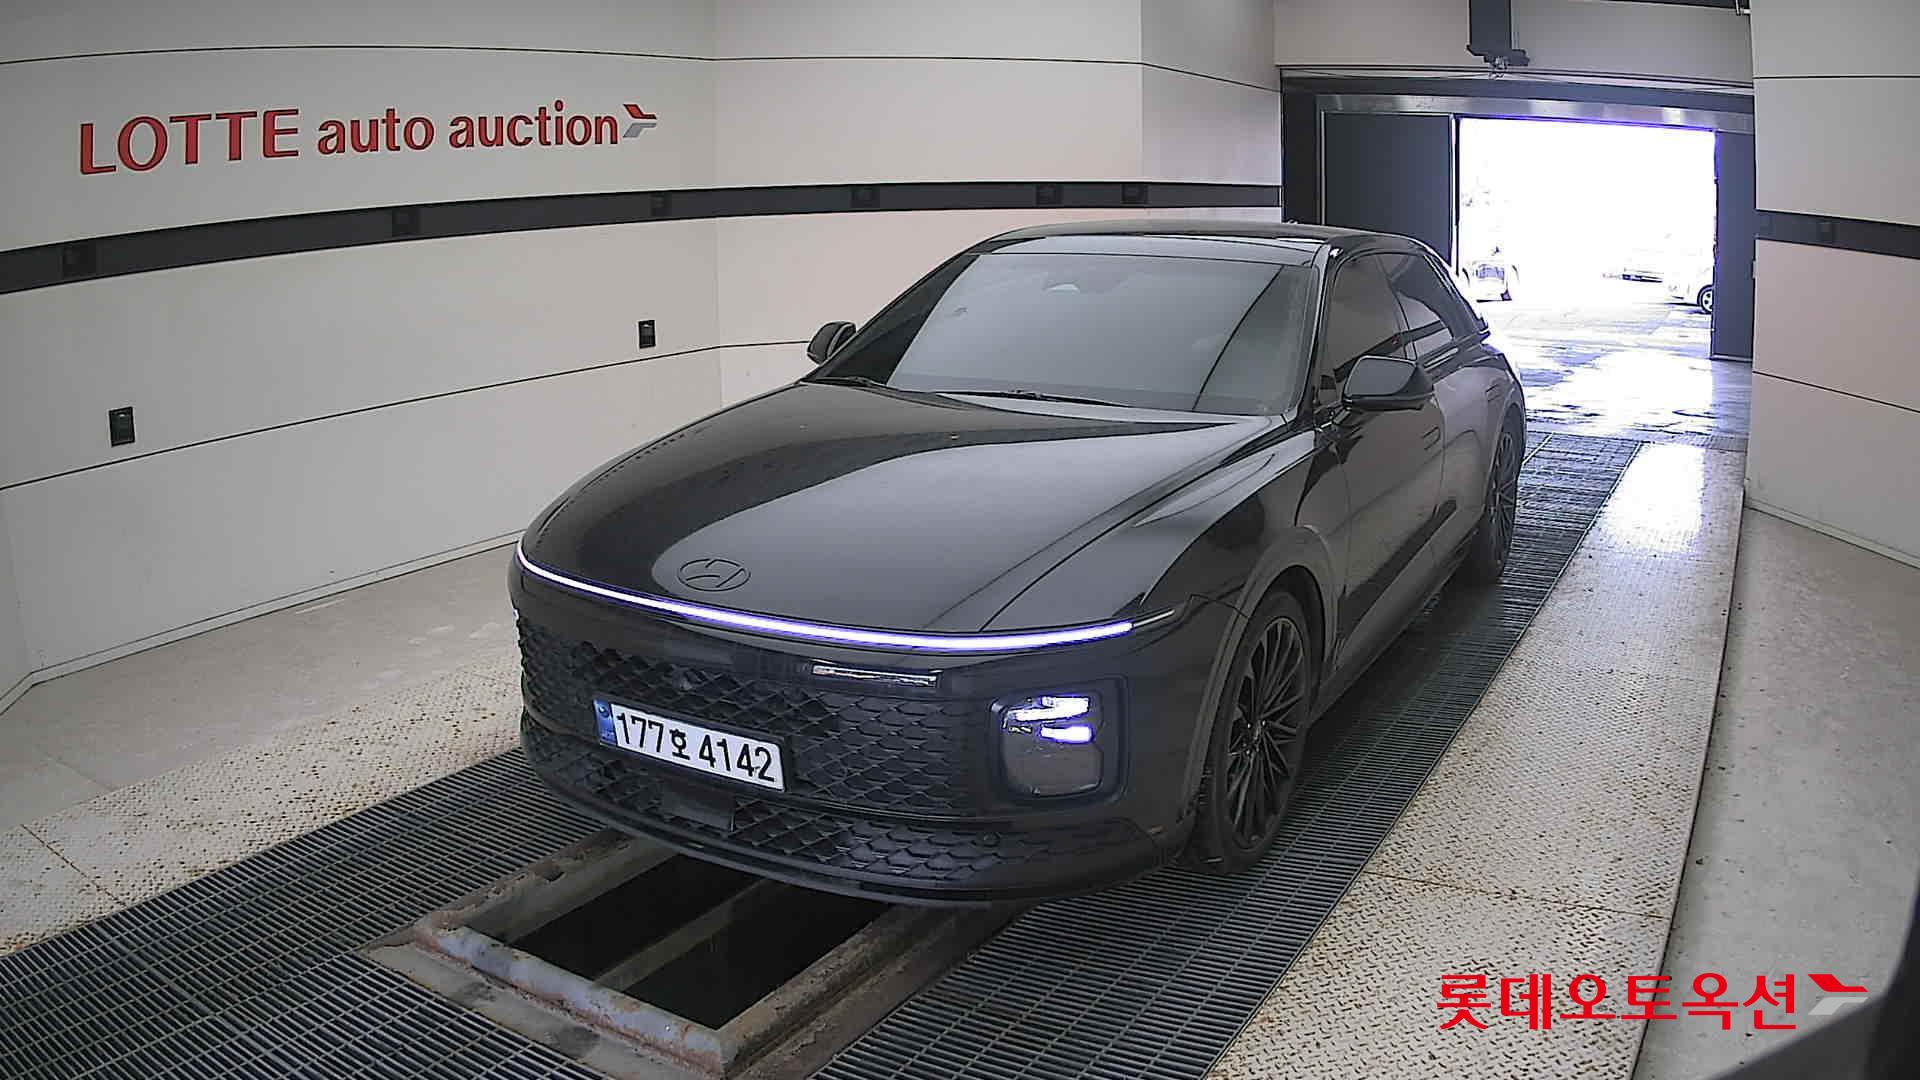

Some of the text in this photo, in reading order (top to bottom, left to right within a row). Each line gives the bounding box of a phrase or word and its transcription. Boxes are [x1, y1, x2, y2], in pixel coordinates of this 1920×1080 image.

[79, 99, 619, 175] LOTTE auto auction
[617, 712, 775, 782] 177호 4142
